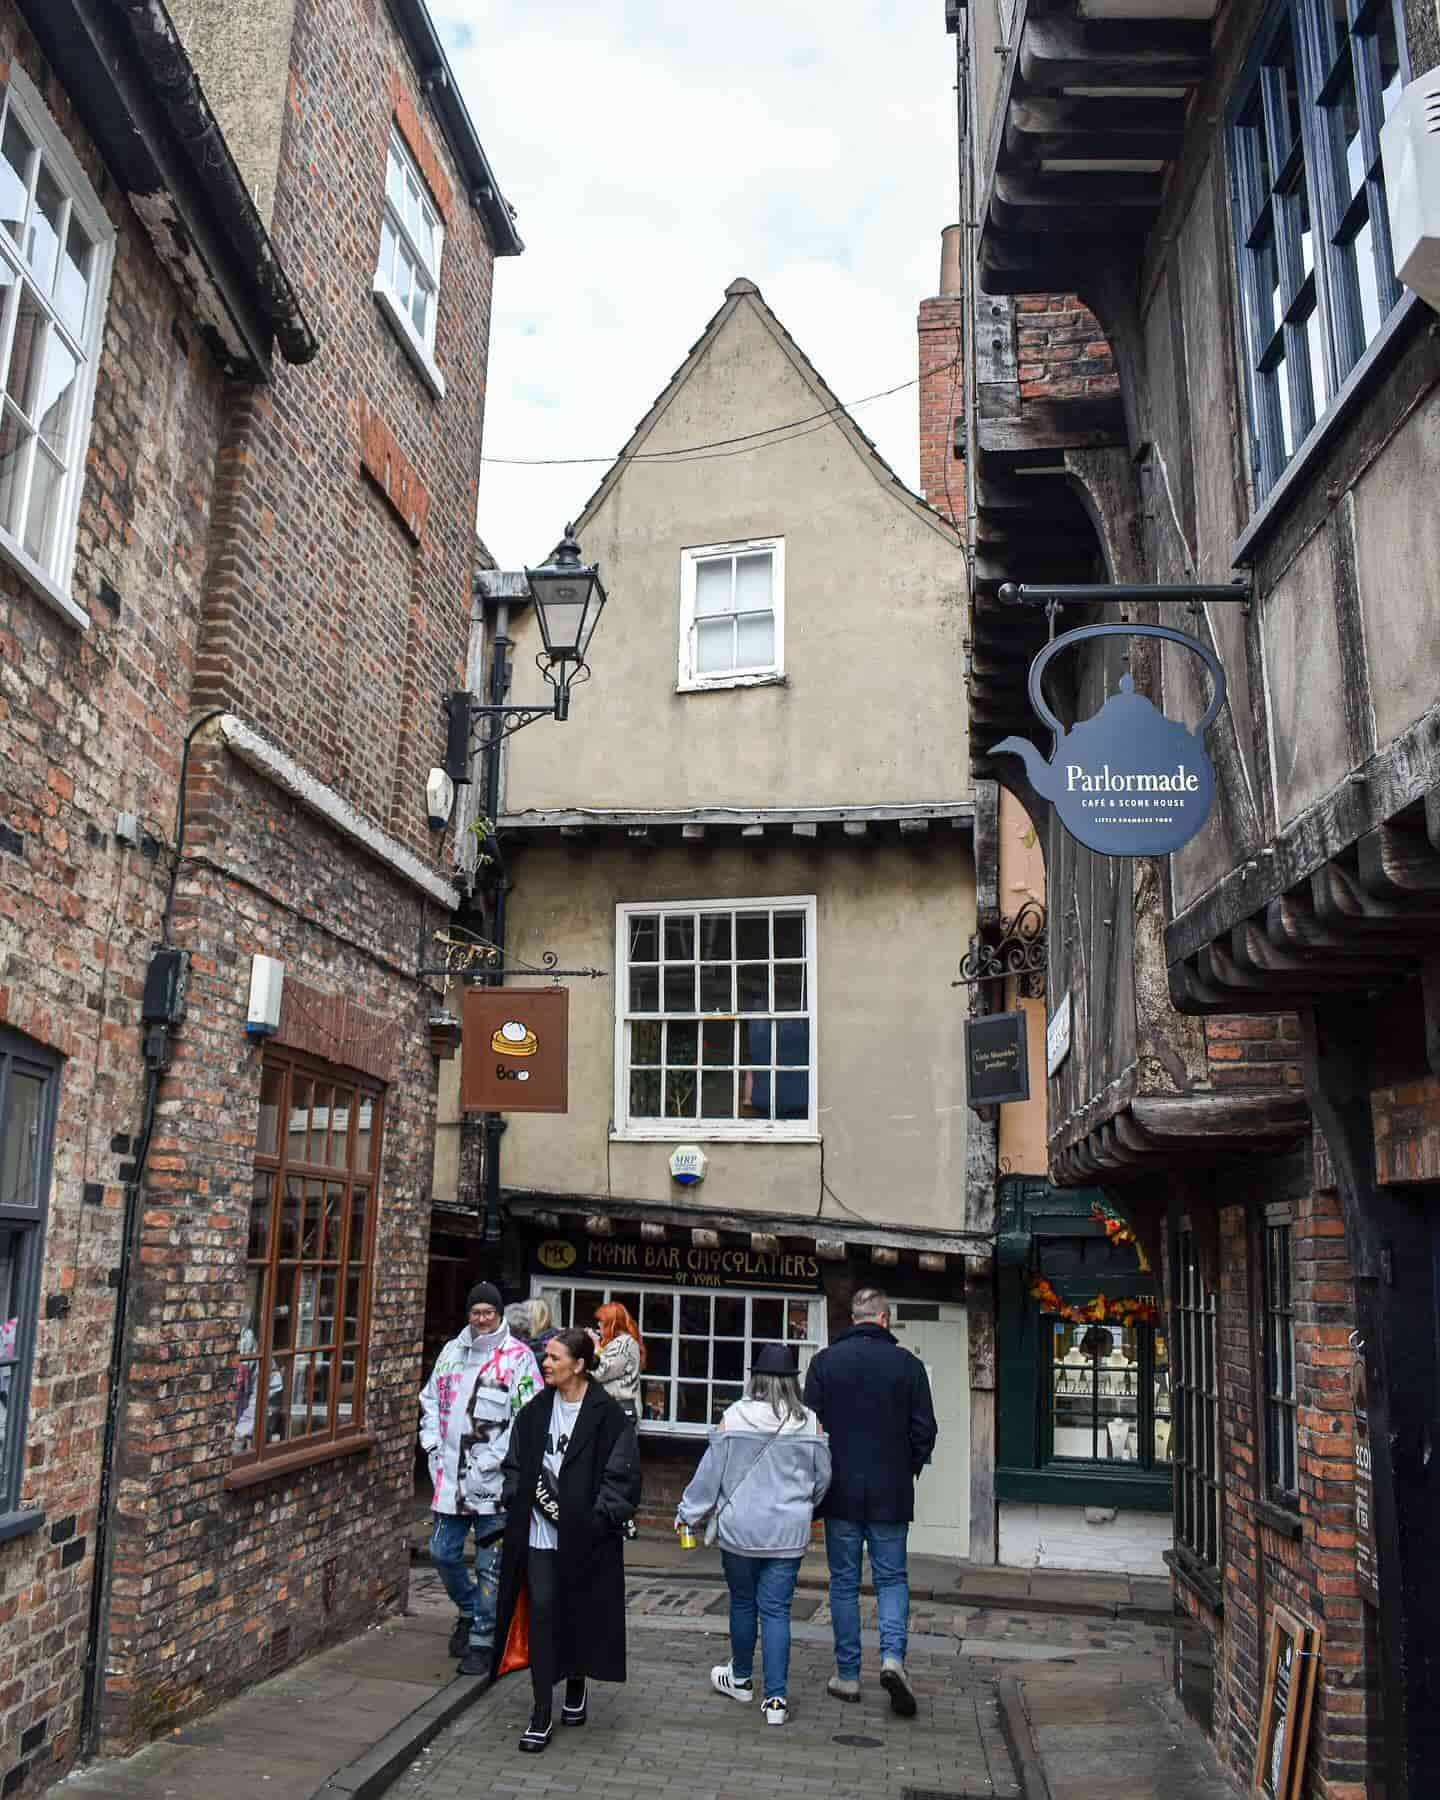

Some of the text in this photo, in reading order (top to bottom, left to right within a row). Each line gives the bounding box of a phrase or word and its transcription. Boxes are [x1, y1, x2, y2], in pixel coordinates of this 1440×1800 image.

[1065, 764, 1199, 792] Parlormade
[1081, 798, 1185, 808] CAFÉ & SCONE HOUSE
[588, 1240, 819, 1278] MONK BAR CHOCOLATIERS
[692, 1273, 721, 1287] YORK
